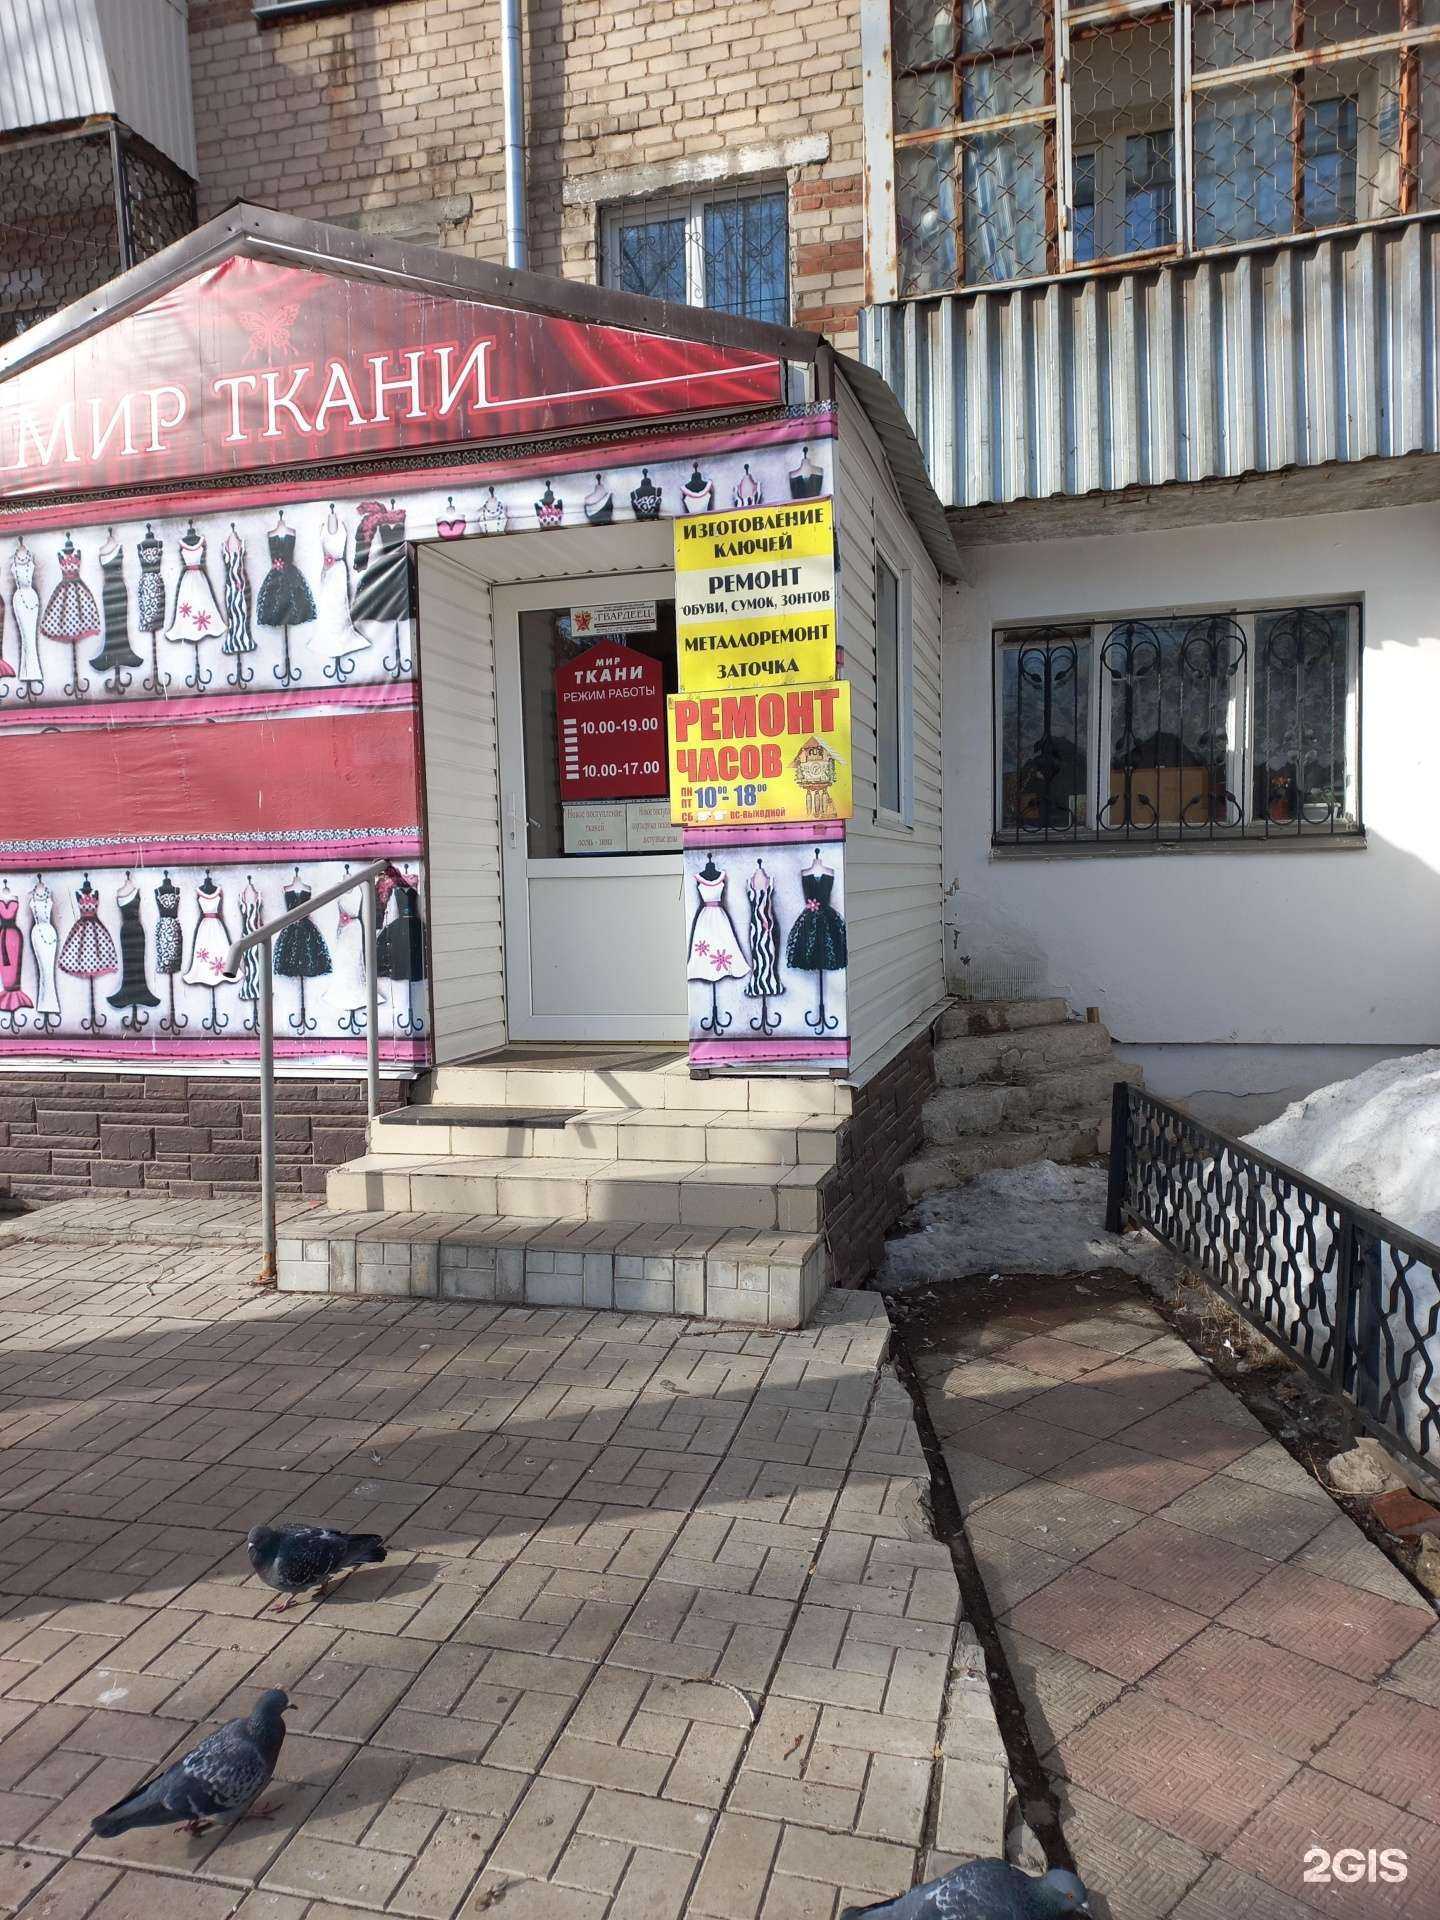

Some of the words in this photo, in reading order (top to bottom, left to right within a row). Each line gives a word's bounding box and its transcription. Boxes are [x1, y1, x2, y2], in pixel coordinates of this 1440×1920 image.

[15, 386, 188, 470] МИР
[213, 340, 493, 443] ТКАНИ
[683, 508, 824, 539] ИЗГОТОВЛЕНИЕ
[714, 531, 793, 558] КЛЮЧЕЙ
[708, 566, 802, 595] РЕМОНТ
[682, 601, 728, 617] ОБУВИ,
[731, 596, 778, 613] СУМОК,
[782, 590, 831, 607] ЗОНТОВ
[685, 624, 830, 652] МЕТАЛЛОРЕМОНТ
[595, 657, 621, 667] МИР
[716, 658, 800, 680] ЗАТОЧКА
[574, 665, 643, 685] ТКАНИ
[563, 689, 606, 703] РЕЖИМ
[608, 685, 657, 699] РАБОТЫ
[580, 717, 659, 735] 10.00-19.00
[674, 688, 840, 743] РЕМОНТ
[582, 760, 660, 778] 10.00-17.00
[676, 743, 783, 783] ЧАСОВ
[681, 787, 693, 797] ПН
[681, 798, 692, 808] ПТ
[681, 811, 693, 822] СБ
